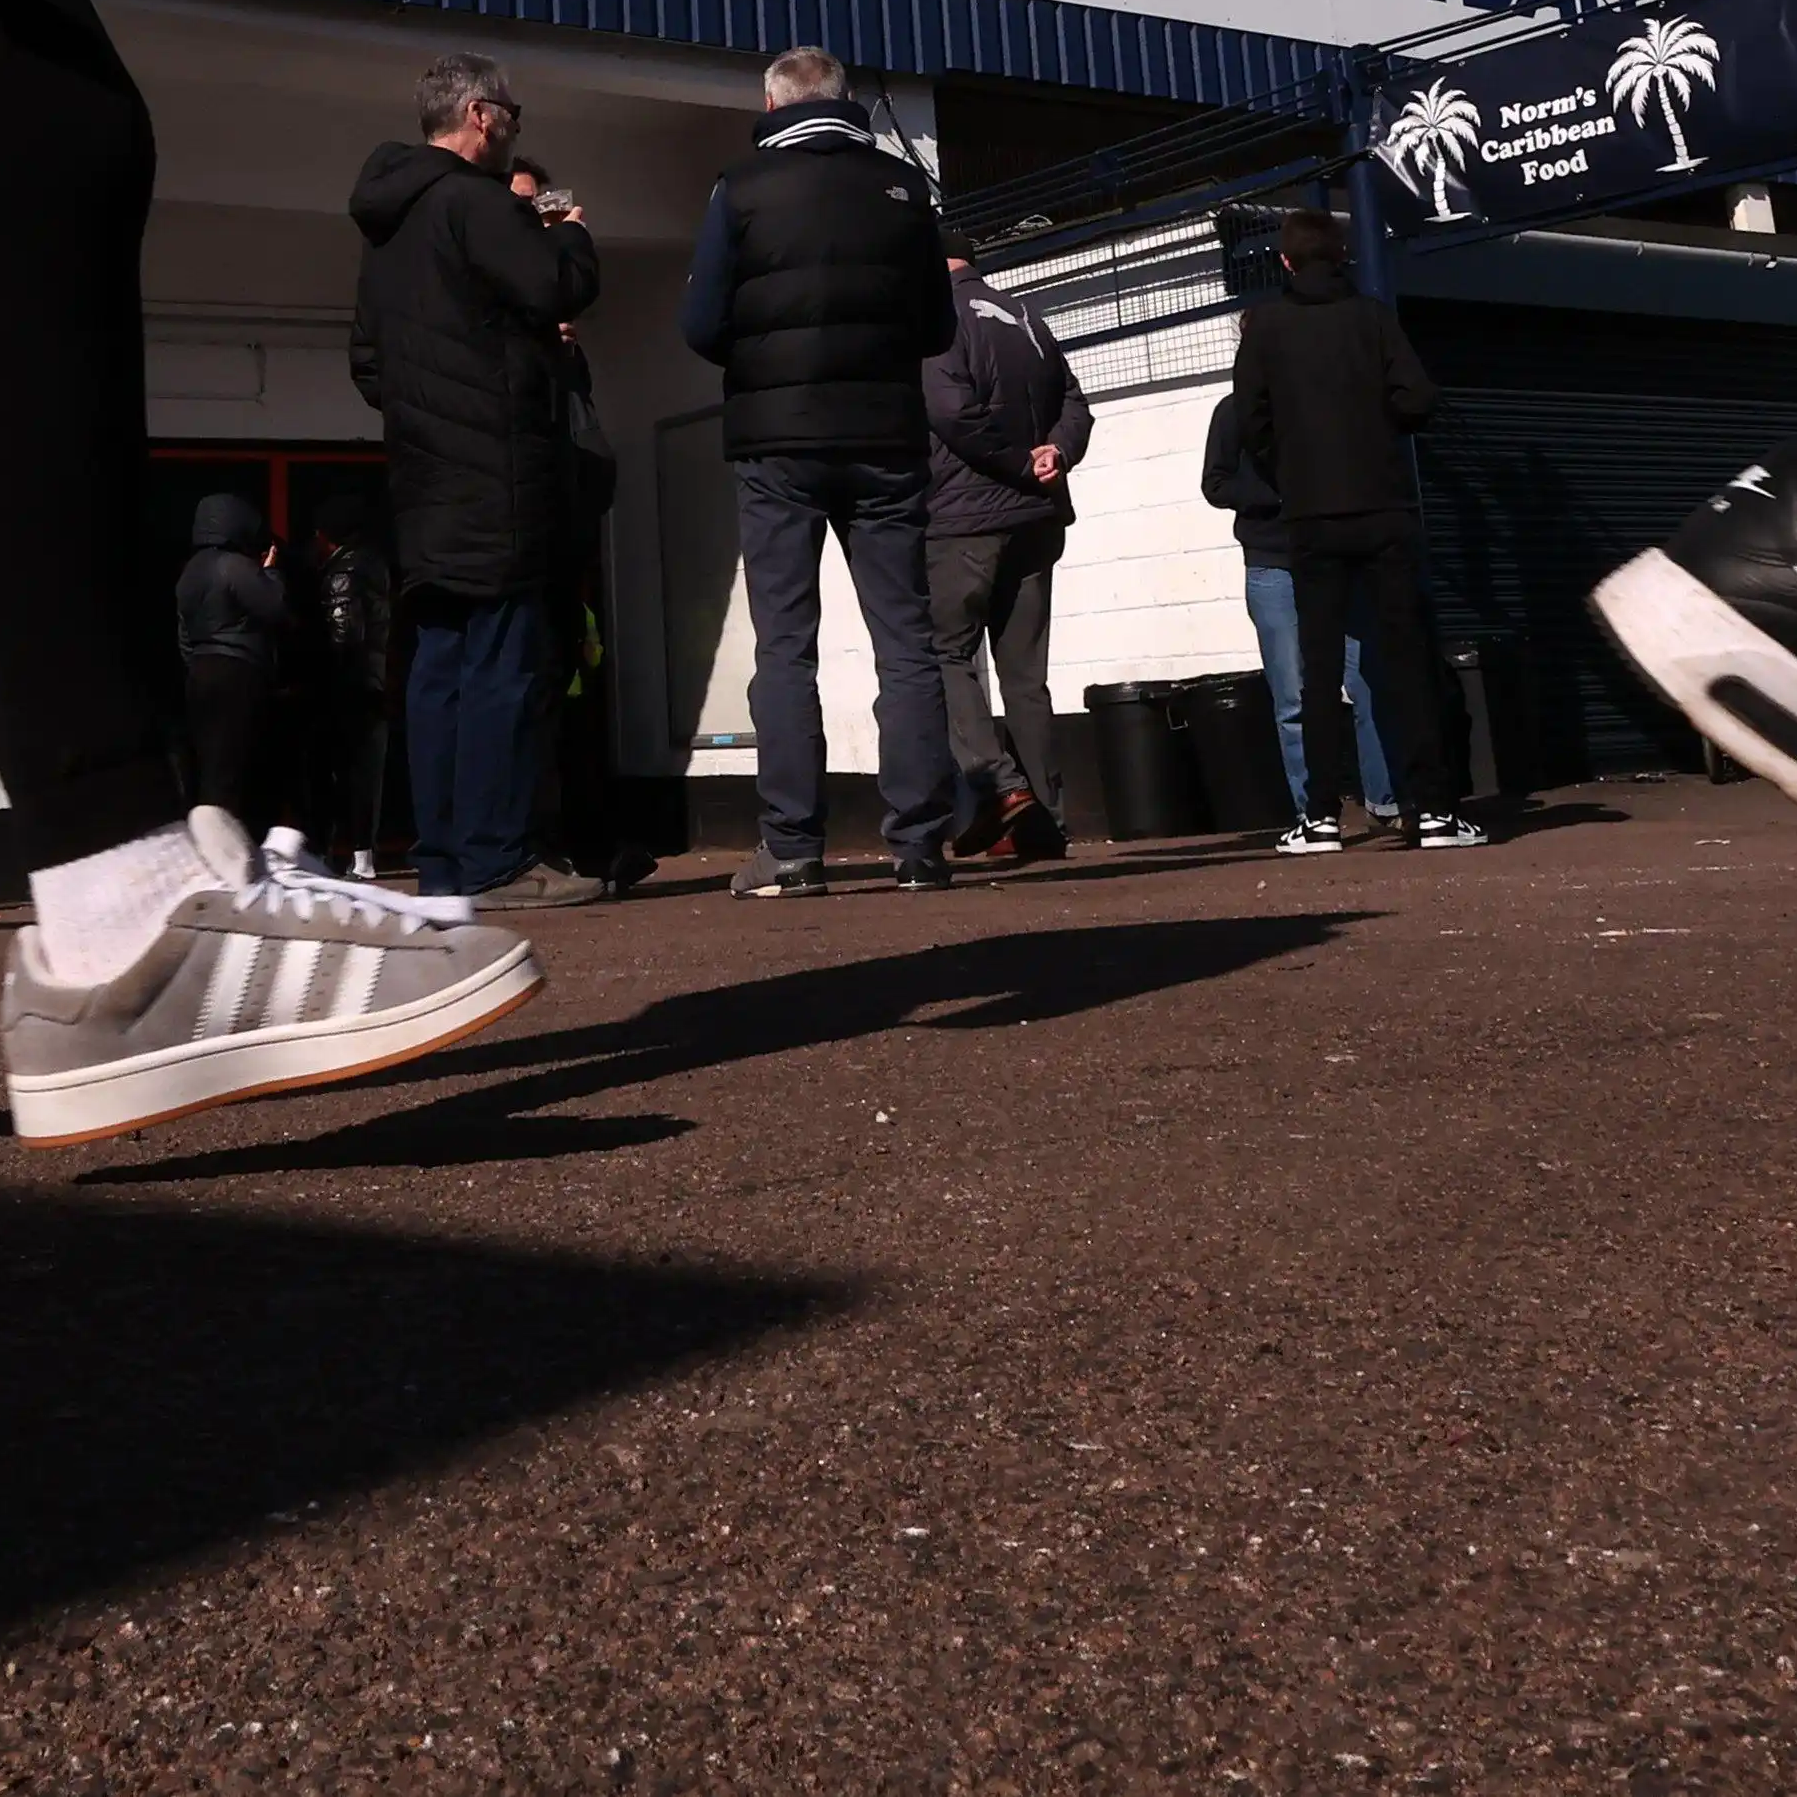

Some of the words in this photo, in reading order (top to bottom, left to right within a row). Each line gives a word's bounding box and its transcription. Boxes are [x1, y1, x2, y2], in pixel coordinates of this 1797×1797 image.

[1499, 86, 1598, 130] Norm's
[1480, 114, 1617, 164] Caribbean
[1519, 149, 1590, 186] Food
